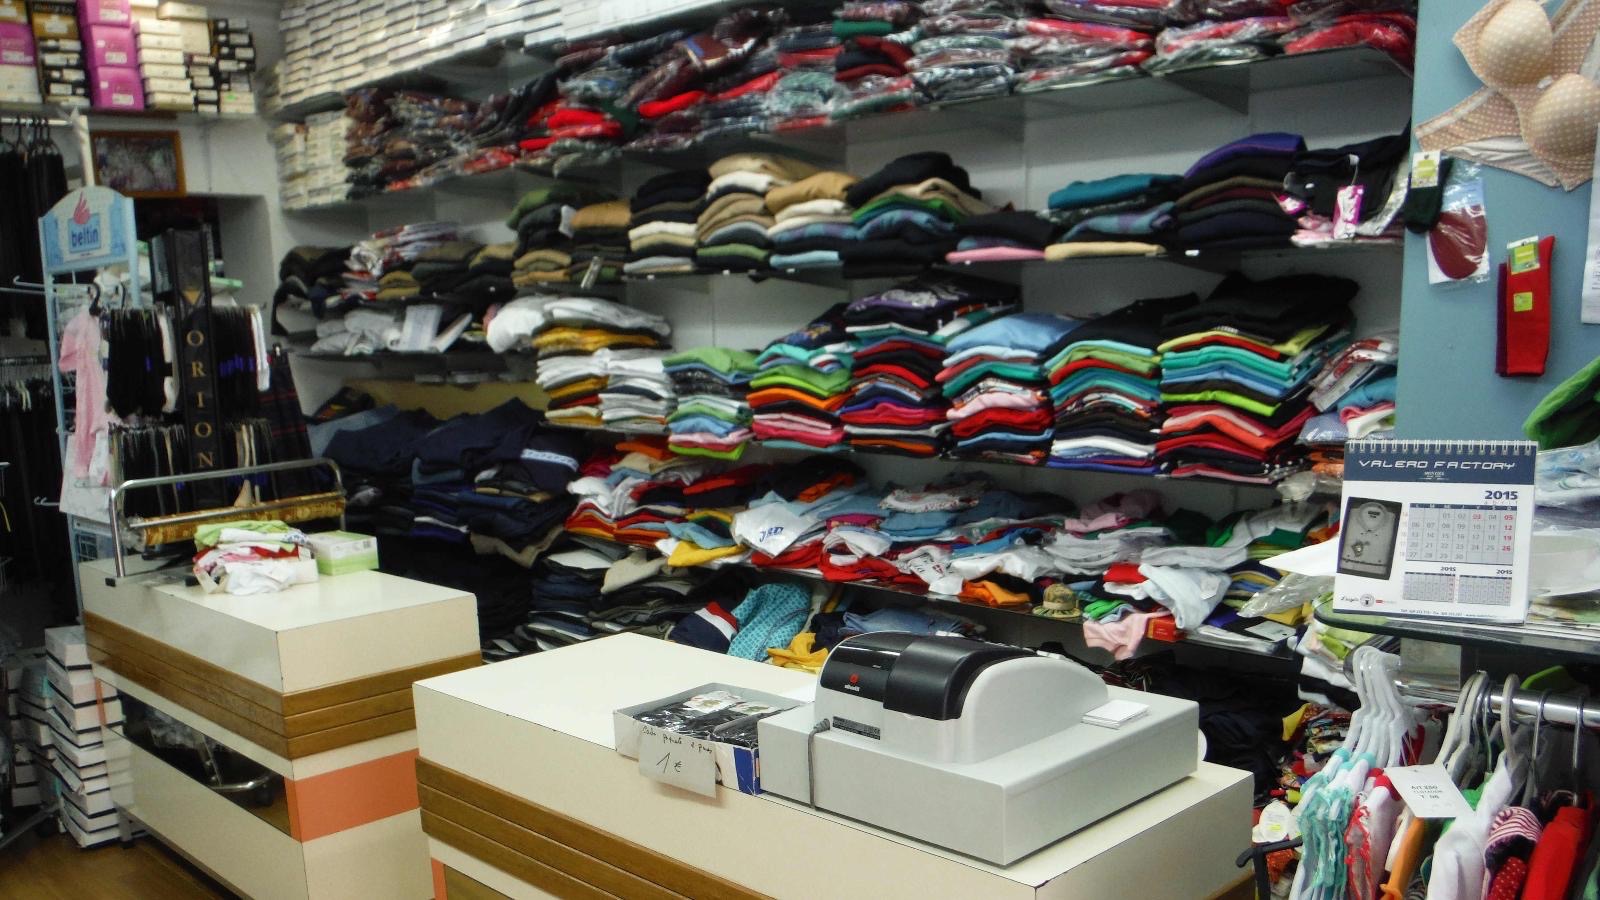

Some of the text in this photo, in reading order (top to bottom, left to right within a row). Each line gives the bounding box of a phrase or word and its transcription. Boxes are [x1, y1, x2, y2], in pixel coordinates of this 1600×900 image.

[71, 226, 99, 247] beltin
[186, 329, 214, 468] ORION
[1358, 460, 1516, 470] VALERO FACTORY
[1484, 490, 1518, 500] 2015
[656, 752, 682, 774] 1 €
